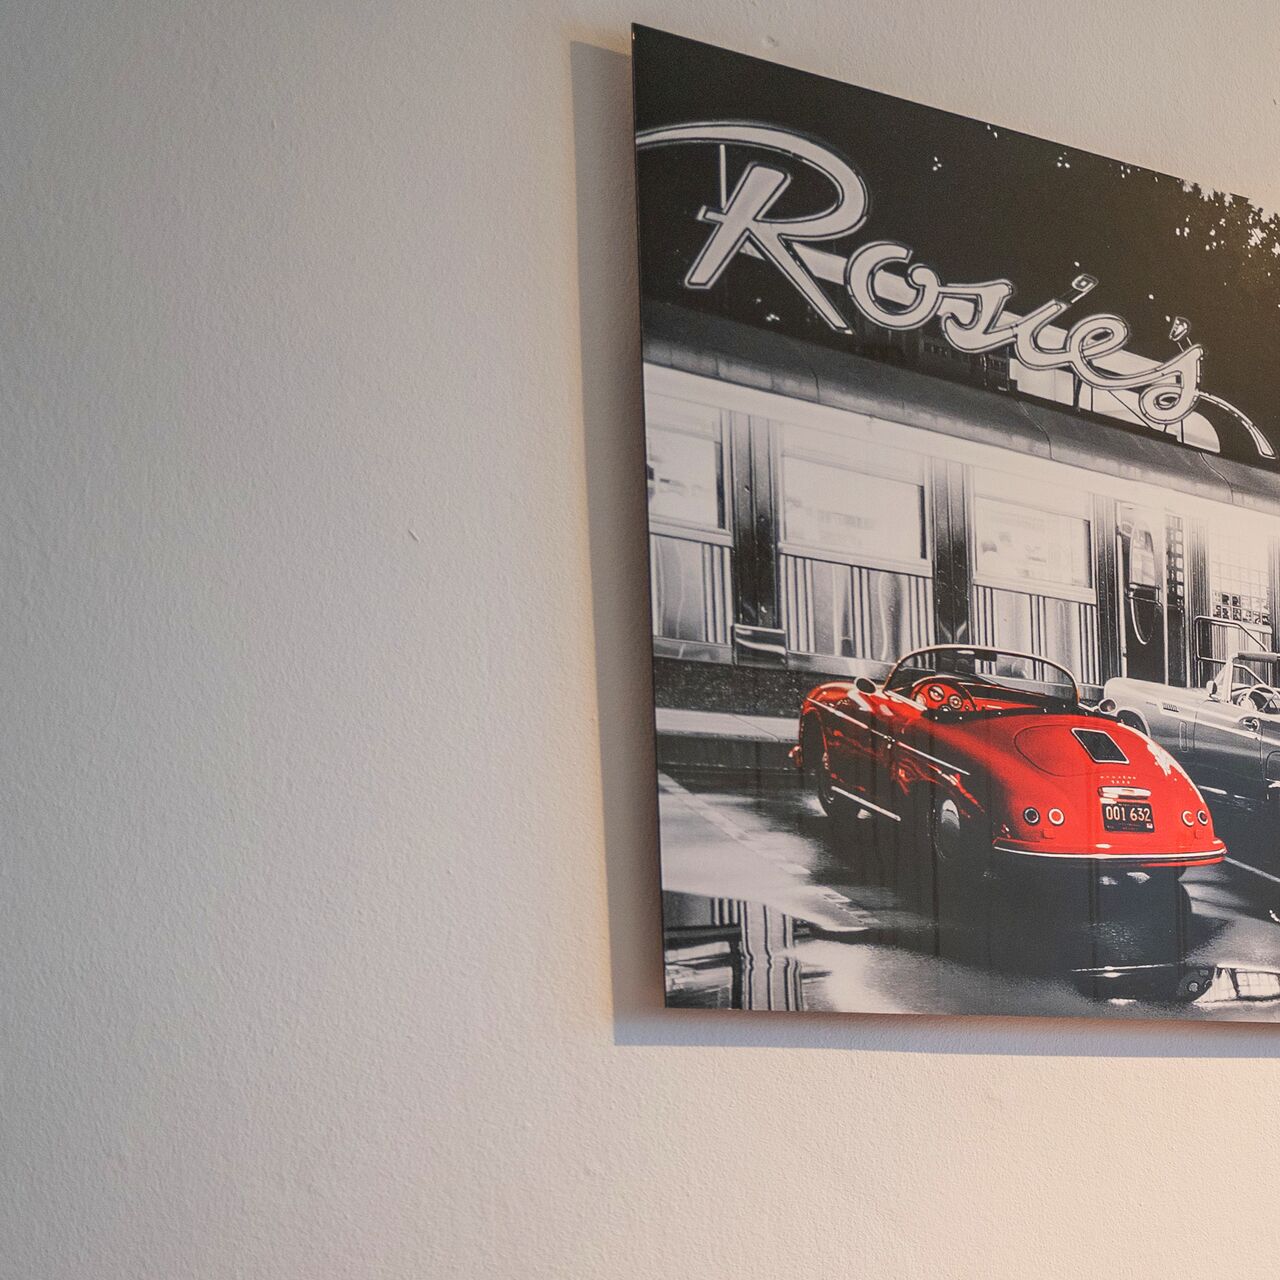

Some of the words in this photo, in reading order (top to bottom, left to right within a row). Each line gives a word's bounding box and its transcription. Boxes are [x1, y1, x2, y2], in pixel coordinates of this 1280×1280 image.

[636, 120, 1206, 426] Rosie's
[1105, 805, 1126, 821] 001
[1129, 807, 1152, 822] 632
